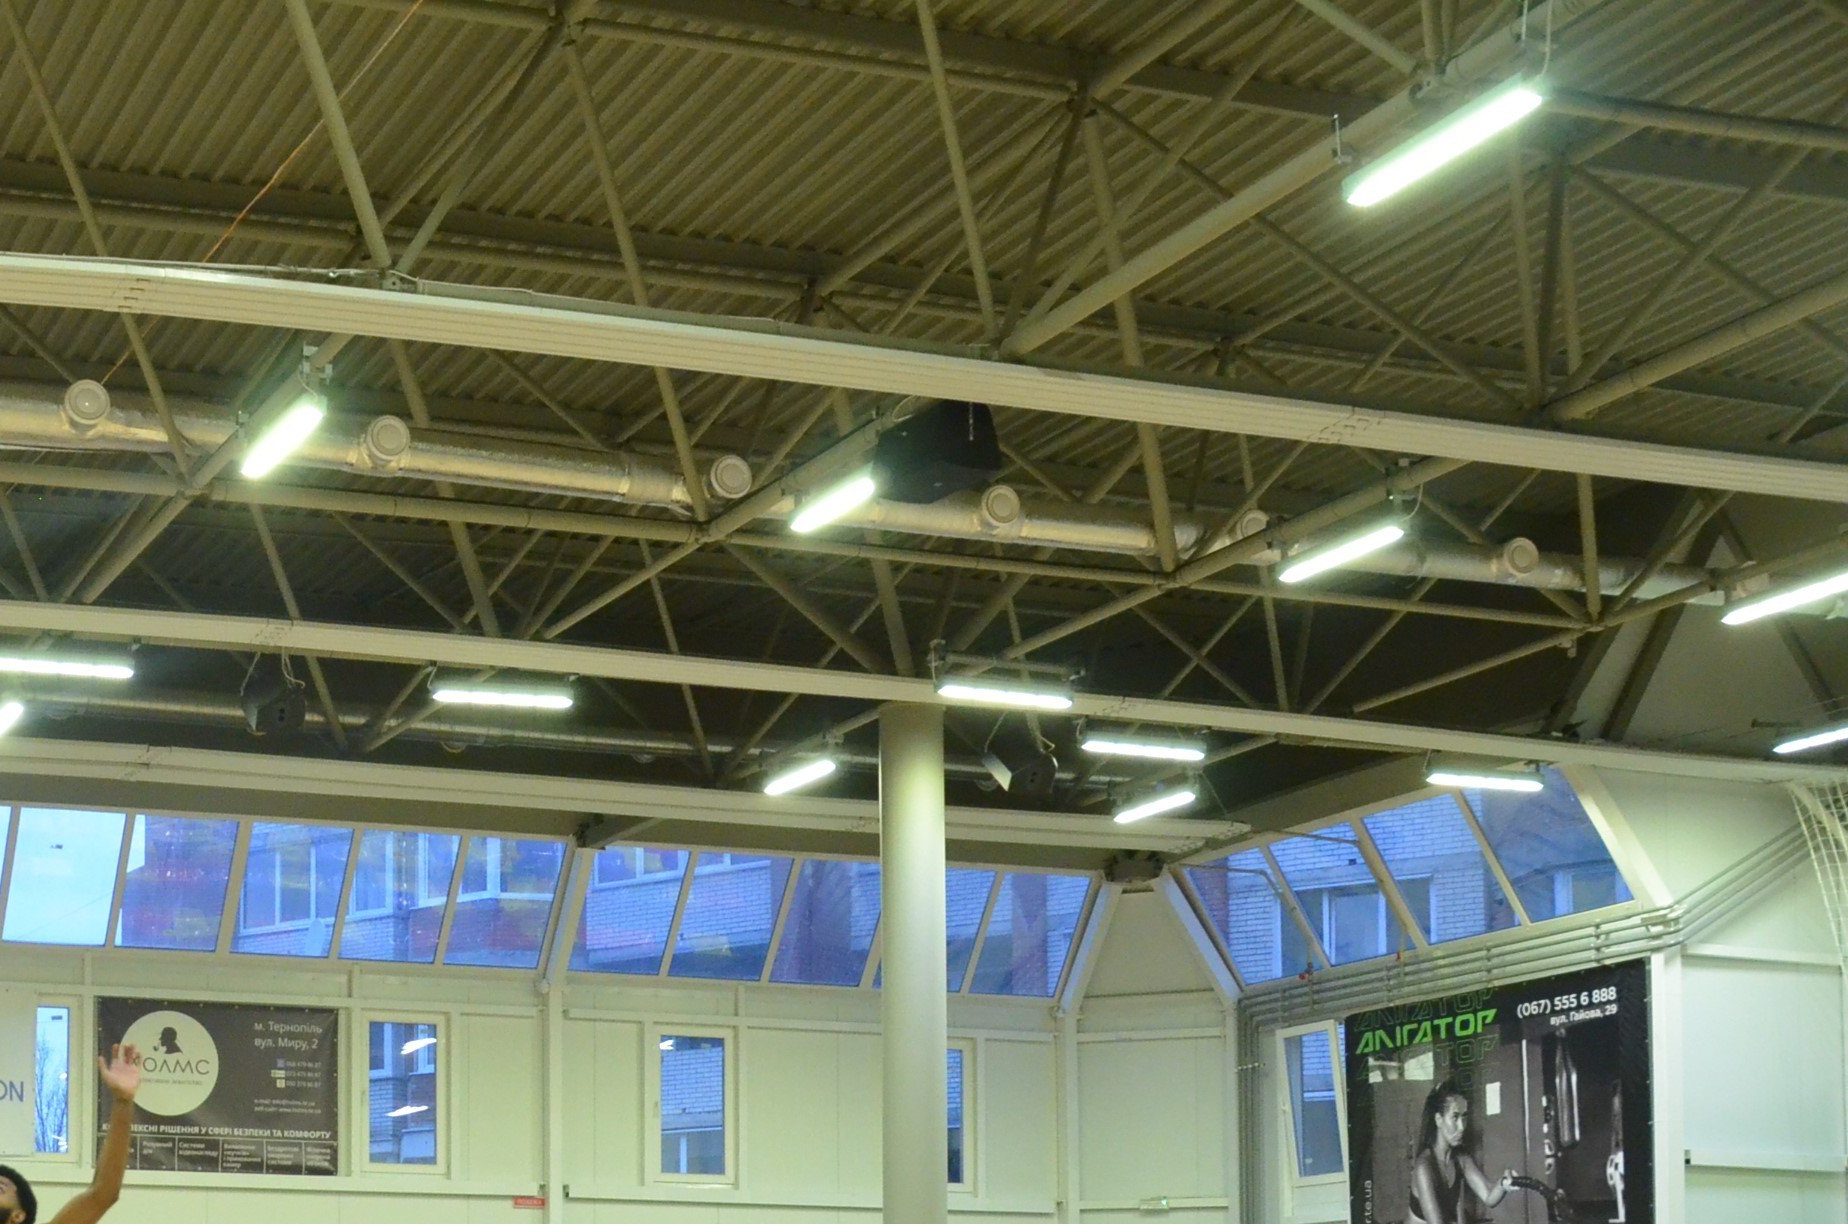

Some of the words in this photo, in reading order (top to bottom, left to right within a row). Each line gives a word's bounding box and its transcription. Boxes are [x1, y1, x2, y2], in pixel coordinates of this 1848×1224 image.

[1517, 999, 1551, 1018] (067)
[1554, 993, 1578, 1011] 555
[1580, 991, 1589, 1006] 6
[1592, 986, 1617, 1003] 888
[1605, 1003, 1618, 1016] 29
[254, 1022, 266, 1031] м.
[268, 1020, 323, 1034] Тернопіль
[254, 1038, 275, 1049] вул.
[278, 1037, 309, 1051] Миру,
[311, 1038, 319, 1049] 2
[159, 1125, 199, 1134] РІШЕННЯ
[200, 1126, 207, 1134] У
[208, 1126, 232, 1135] СФЕРІ
[234, 1128, 270, 1137] БЕЗПЕКИ
[272, 1129, 282, 1138] ТА
[284, 1130, 331, 1139] КОМФОРТУ
